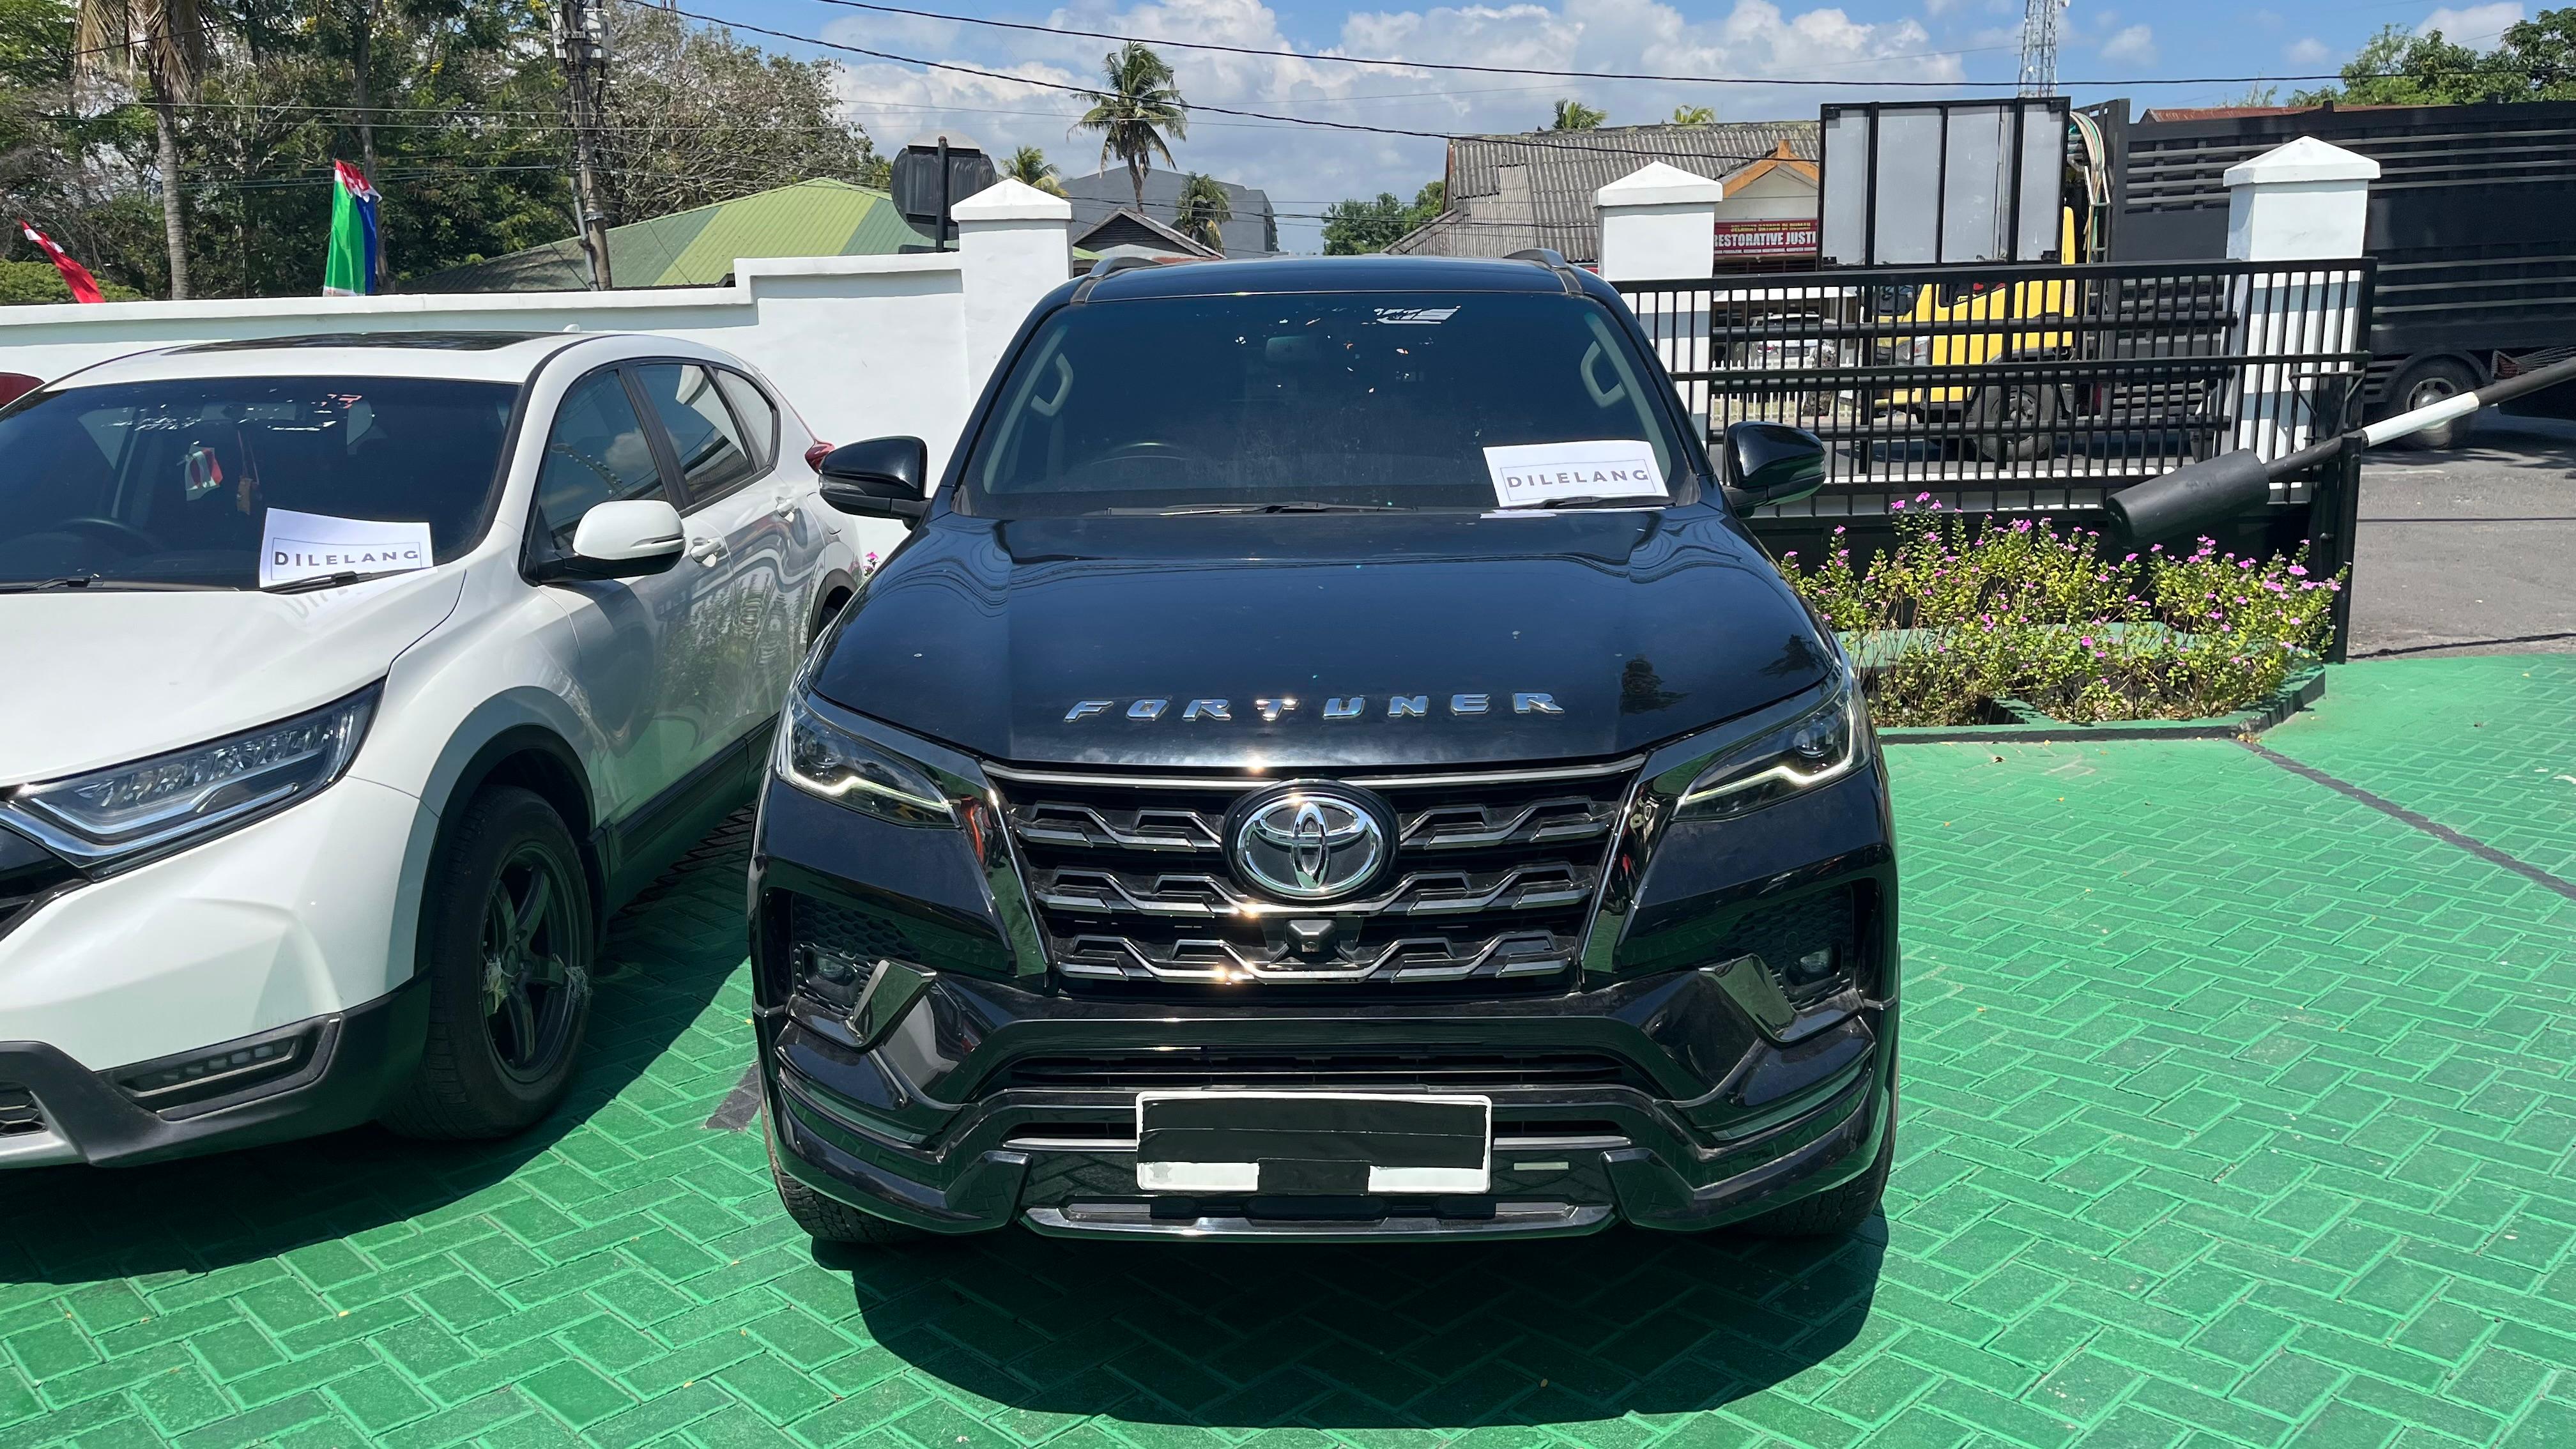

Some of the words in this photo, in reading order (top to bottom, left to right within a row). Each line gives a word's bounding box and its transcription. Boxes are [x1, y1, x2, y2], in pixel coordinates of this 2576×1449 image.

[1713, 232, 1784, 247] RESTORATIVE
[1506, 470, 1649, 488] DILELANG
[274, 549, 419, 567] DILELANG
[1063, 692, 1565, 723] FORTUNER
